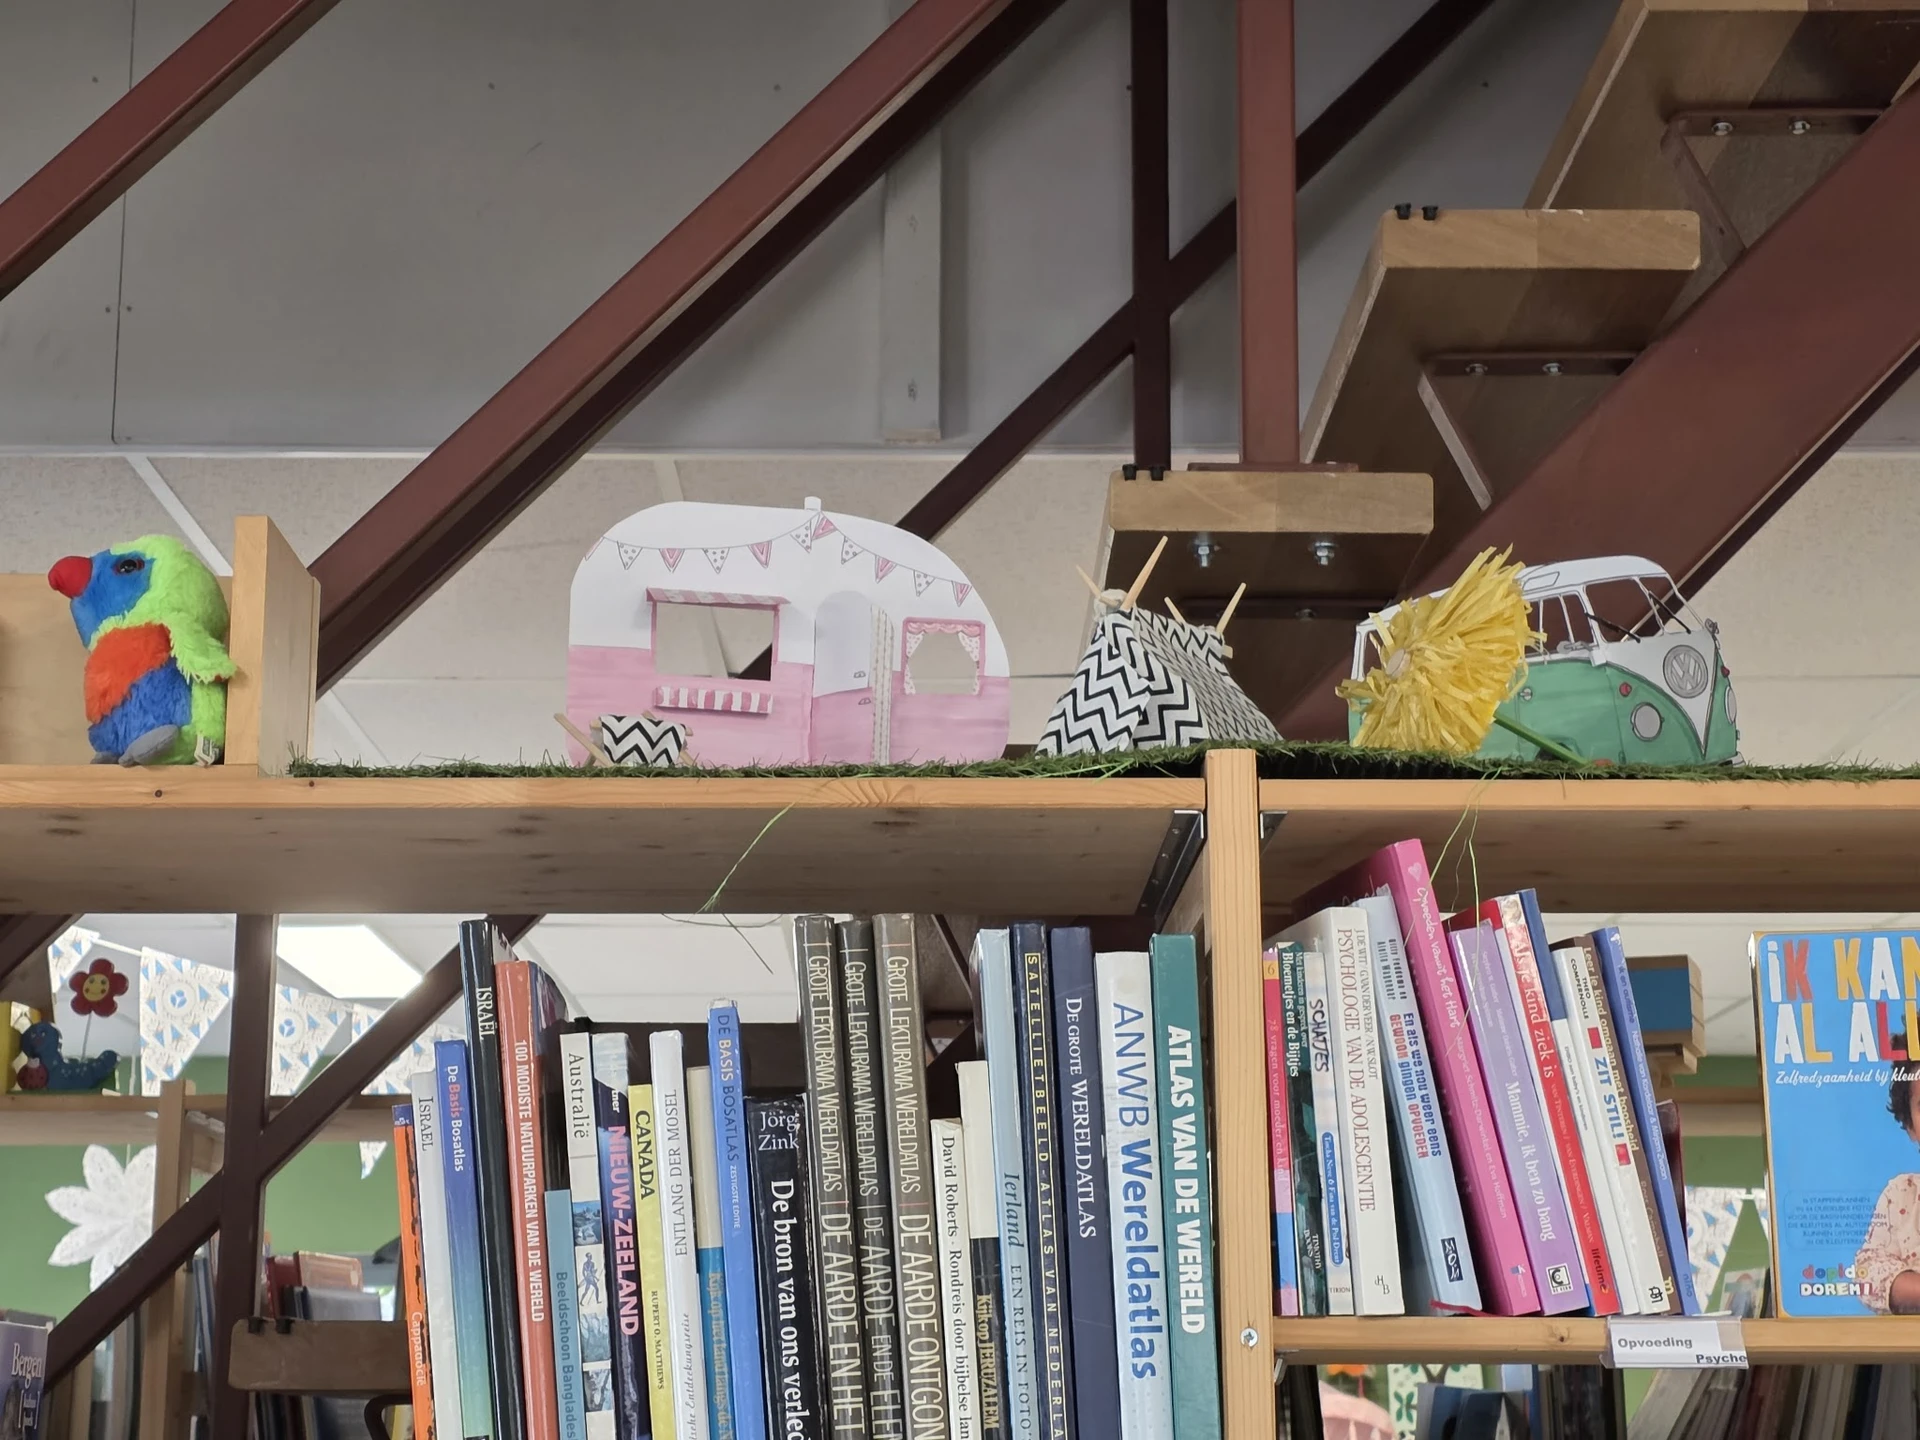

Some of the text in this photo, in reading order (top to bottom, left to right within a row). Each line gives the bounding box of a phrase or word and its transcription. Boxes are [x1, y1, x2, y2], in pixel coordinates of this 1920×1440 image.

[1412, 887, 1438, 941] Opvoeden
[1267, 963, 1275, 976] 6
[1430, 941, 1447, 976] vanuit
[1439, 975, 1454, 999] het
[1619, 975, 1627, 987] en
[476, 986, 498, 1040] ISRAËL
[1282, 952, 1301, 1078] Bloemetjes en de Bijtjes
[1445, 1001, 1461, 1028] Hart
[1525, 988, 1549, 1025] kind
[1570, 958, 1590, 1020] COMPERNOLLE
[1582, 976, 1592, 1000] THEO
[717, 1014, 731, 1034] DE
[1363, 1011, 1374, 1033] VEER
[1534, 1028, 1555, 1061] ziek
[1583, 947, 1639, 1152] Leer kind omgaan met boosheid
[1774, 1002, 1833, 1064] AL
[718, 1038, 733, 1081] BASIS
[808, 955, 843, 1193] GROTE LEKTURAMA WERELDATLAS
[844, 961, 879, 1197] GROTE LEKTURAMA WERELDATLAS
[886, 956, 921, 1194] GROTE LEKTURAMA WERELDATLAS
[1337, 928, 1376, 1212] PSYCHOLOGIE VAN DE ADOLESCENTIE
[1389, 1013, 1430, 1159] GEWOON gingen OPVOEDEN
[1403, 1012, 1442, 1157] En als we nou weer eens
[1543, 1064, 1557, 1079] is
[1775, 1067, 1873, 1089] Zelfredzaamheid
[446, 1065, 466, 1172] De Basis Bosatlas
[568, 1053, 590, 1139] Australië
[760, 1110, 797, 1132] Jörg
[1269, 1033, 1286, 1155] vragen voor moeder en
[1594, 1056, 1625, 1139] ZIT STIL!
[418, 1096, 434, 1151] ISRAEL
[723, 1085, 739, 1161] BOSATLAS
[758, 1132, 799, 1151] Zink
[1026, 955, 1054, 1254] SATELLIETBEELD-ATLAS
[1044, 1269, 1057, 1312] VAN
[1067, 1025, 1097, 1239] GROTE WERELDATLAS
[514, 1040, 545, 1322] 100 MOOISTE NATUURPARKEN VAN DE WERELD
[635, 1110, 655, 1200] CANADA
[665, 1089, 687, 1256] ENTLANG DER MOSEL
[942, 1136, 957, 1178] David
[1167, 1025, 1206, 1334] ATLAS VAN DE WERELD
[1485, 1152, 1492, 1164] en
[1505, 1080, 1556, 1242] Mammie, ik ben zo bang
[729, 1165, 739, 1203] ZESTIGSTE
[770, 1178, 795, 1213] De
[945, 1184, 959, 1238] Roberts
[1113, 1002, 1163, 1379] ANWB Wereldatlas
[608, 1125, 640, 1336] NIEUW-ZEELAND
[773, 1217, 798, 1273] bron
[899, 1214, 932, 1248] DE
[776, 1277, 797, 1321] van
[901, 1251, 939, 1336] AARDE
[949, 1250, 965, 1315] Rondreis
[1003, 1173, 1029, 1373] Ierland EEN REIS IN
[1591, 1247, 1609, 1294] lifetime
[1800, 1282, 1872, 1297] DOREMI
[821, 1213, 866, 1434] DE AARDE EN HET
[859, 1216, 896, 1383] DE AARDE EN DE
[556, 1271, 577, 1440] Beeldschoon Banglades
[651, 1290, 665, 1390] RUPERT MATTHEWS
[680, 1313, 695, 1410] Entdeckungsreise
[780, 1329, 799, 1368] ons
[952, 1319, 967, 1351] door
[976, 1294, 999, 1429] Kijk op JERUZALEM
[1617, 1337, 1693, 1350] Opvoeding
[1695, 1353, 1747, 1365] Psyche
[11, 1342, 43, 1389] Bergen
[955, 1355, 972, 1412] bijbelse
